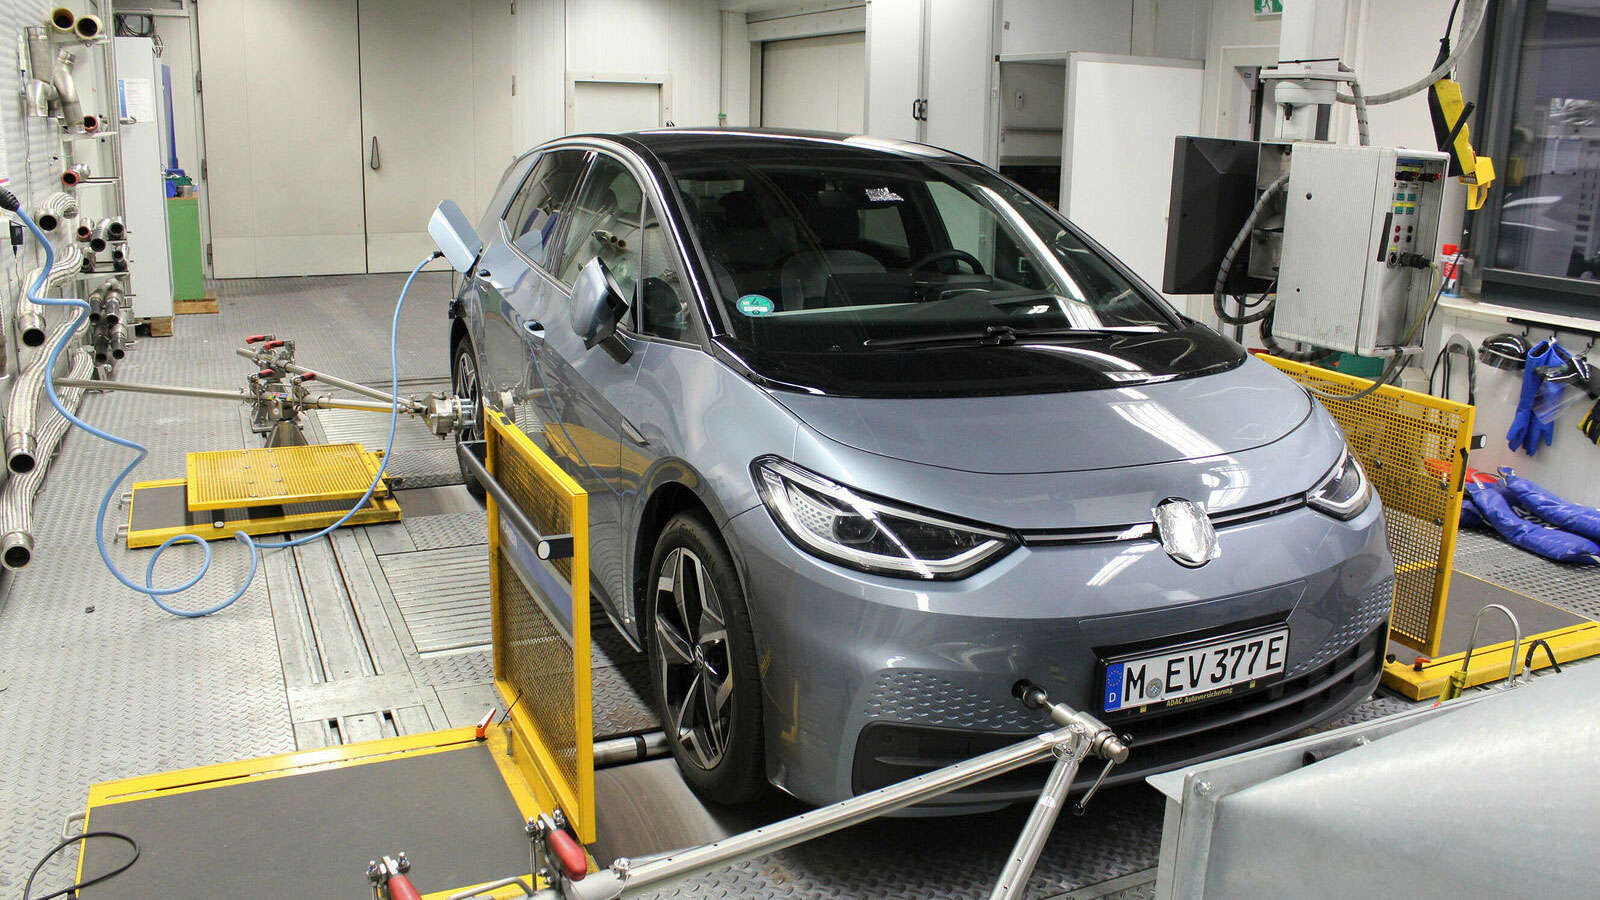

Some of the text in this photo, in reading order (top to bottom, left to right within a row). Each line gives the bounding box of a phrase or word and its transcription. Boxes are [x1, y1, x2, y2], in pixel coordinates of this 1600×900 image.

[1124, 663, 1147, 702] M
[1108, 692, 1117, 703] D
[1166, 688, 1233, 708] ADAC Autoversicherung
